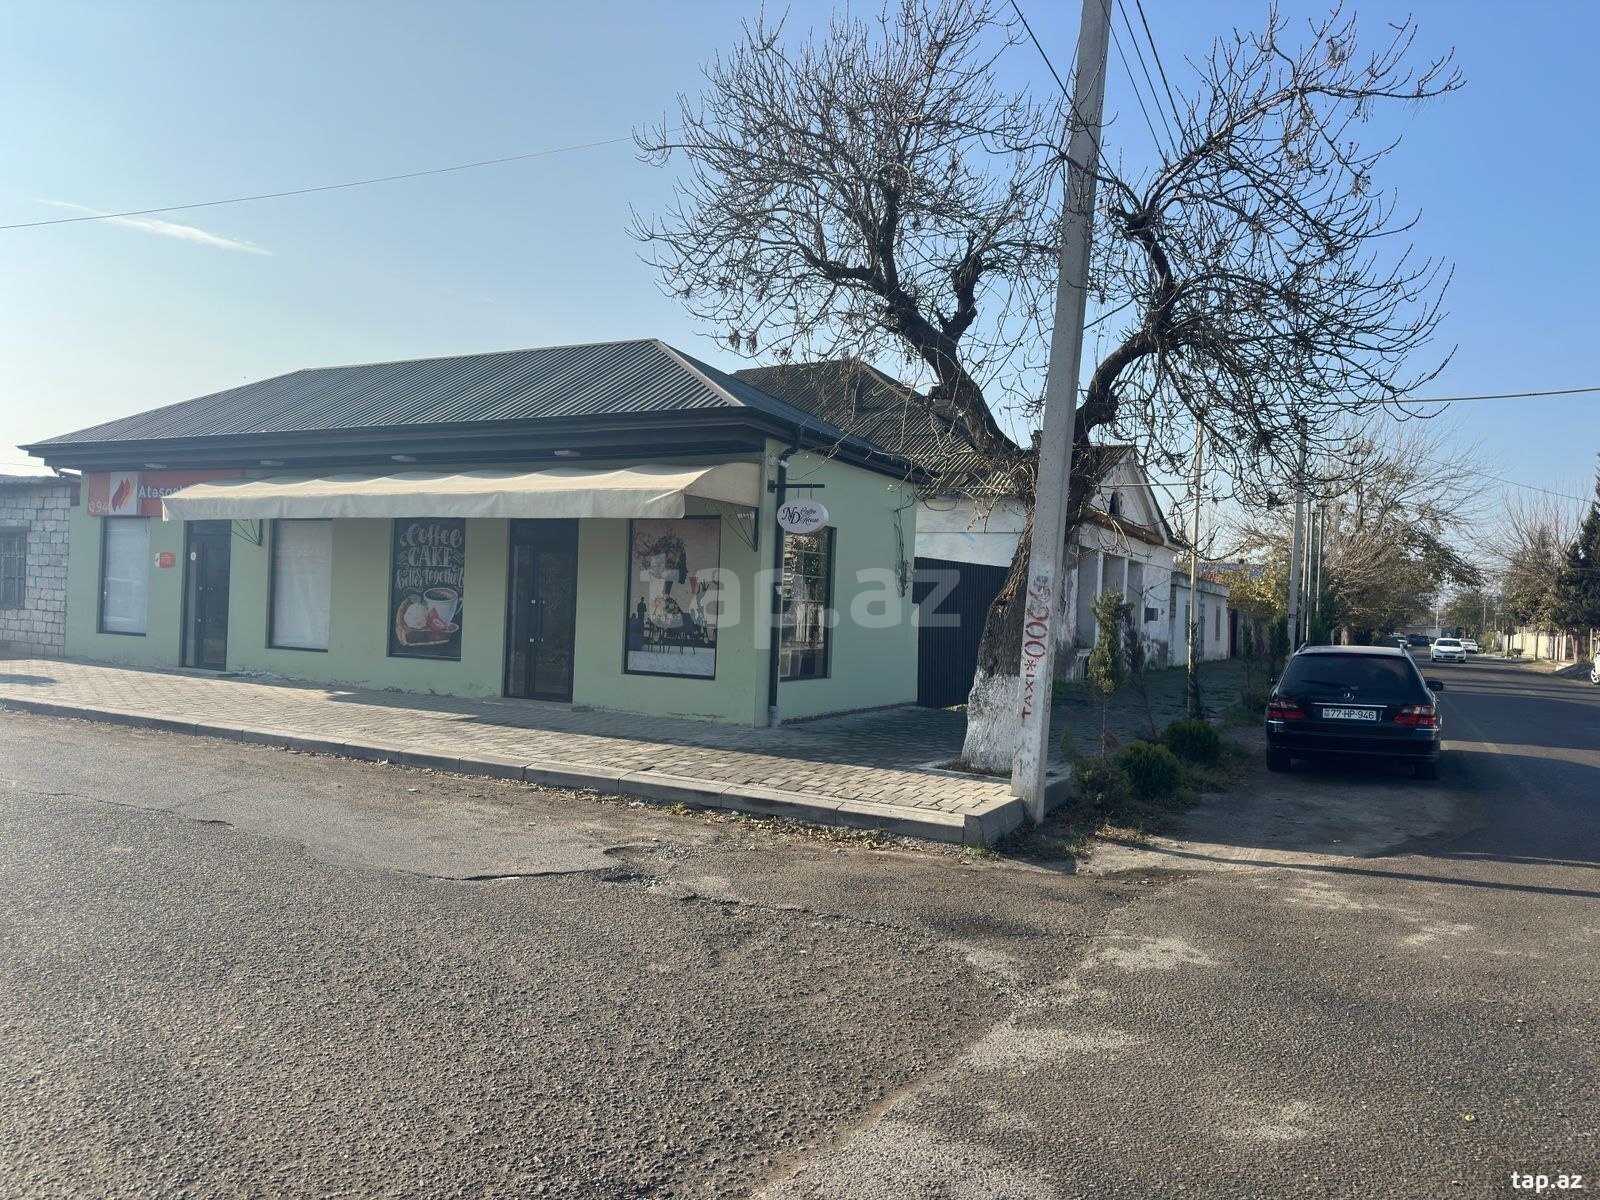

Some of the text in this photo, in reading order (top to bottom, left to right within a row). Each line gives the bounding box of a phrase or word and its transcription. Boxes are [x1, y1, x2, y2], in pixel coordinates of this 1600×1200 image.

[782, 506, 801, 524] ND
[800, 506, 816, 516] Coffee
[400, 523, 462, 548] Coffee
[408, 546, 452, 567] CAKE
